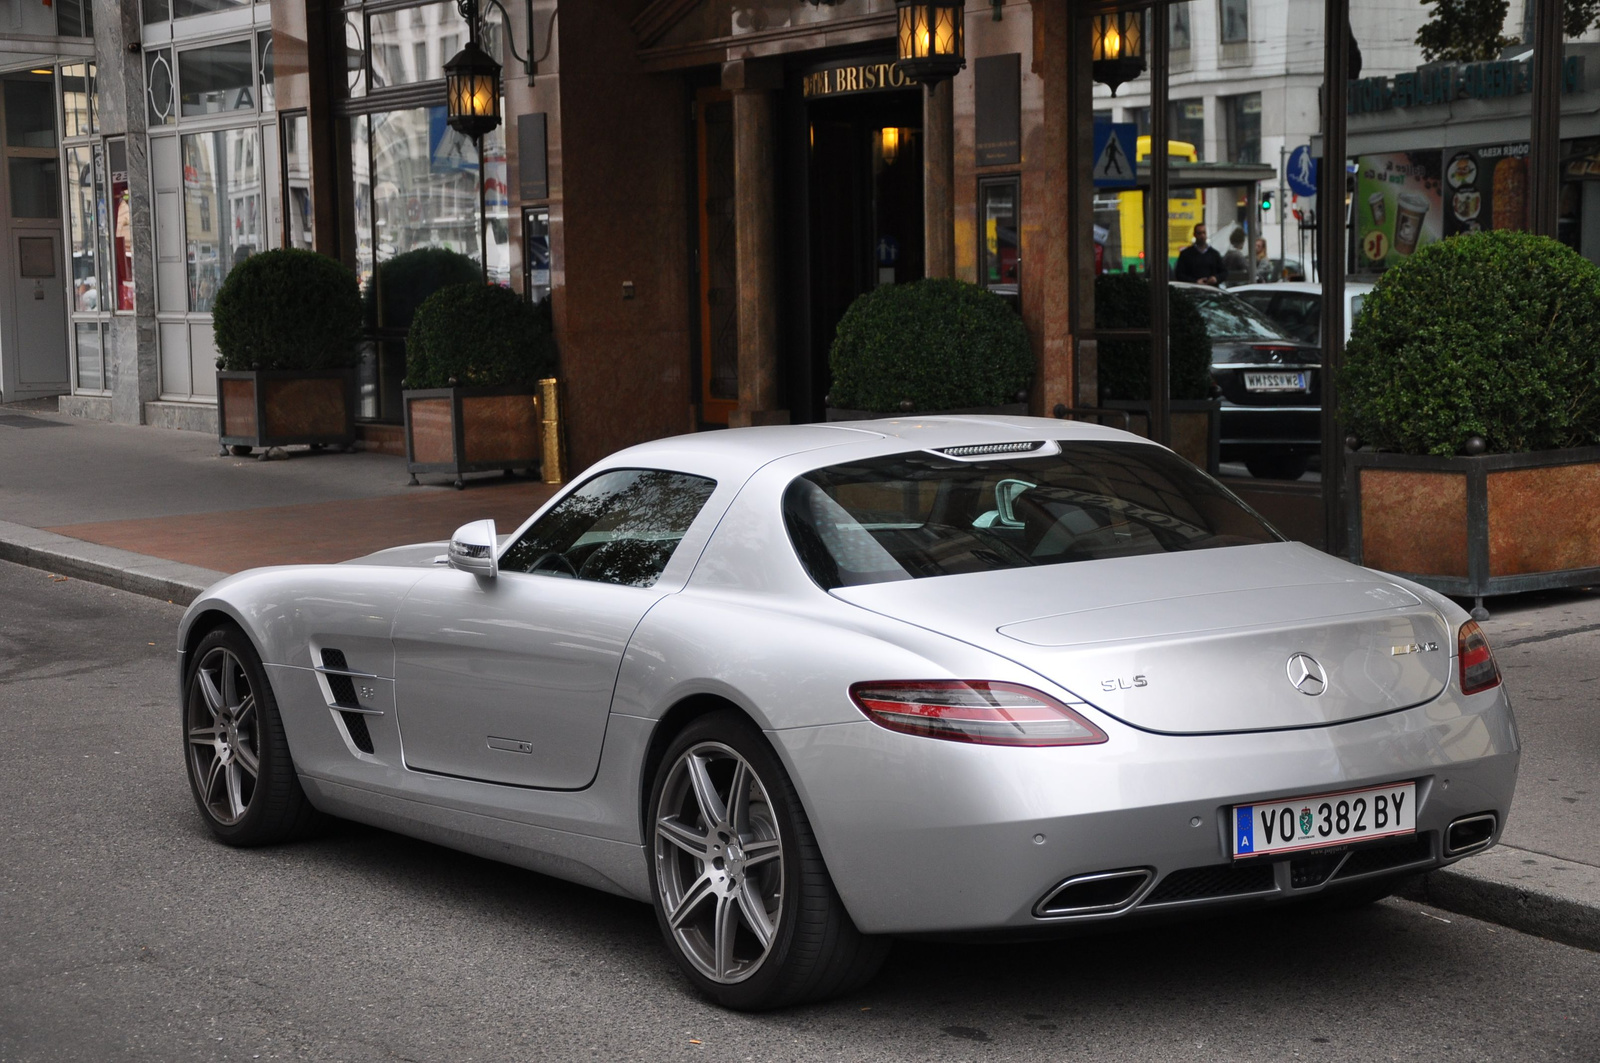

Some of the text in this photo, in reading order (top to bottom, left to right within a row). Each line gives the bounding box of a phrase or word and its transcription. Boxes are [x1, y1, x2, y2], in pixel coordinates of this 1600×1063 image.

[1100, 674, 1149, 692] SLS
[1260, 807, 1296, 845] VO
[1241, 835, 1249, 847] A
